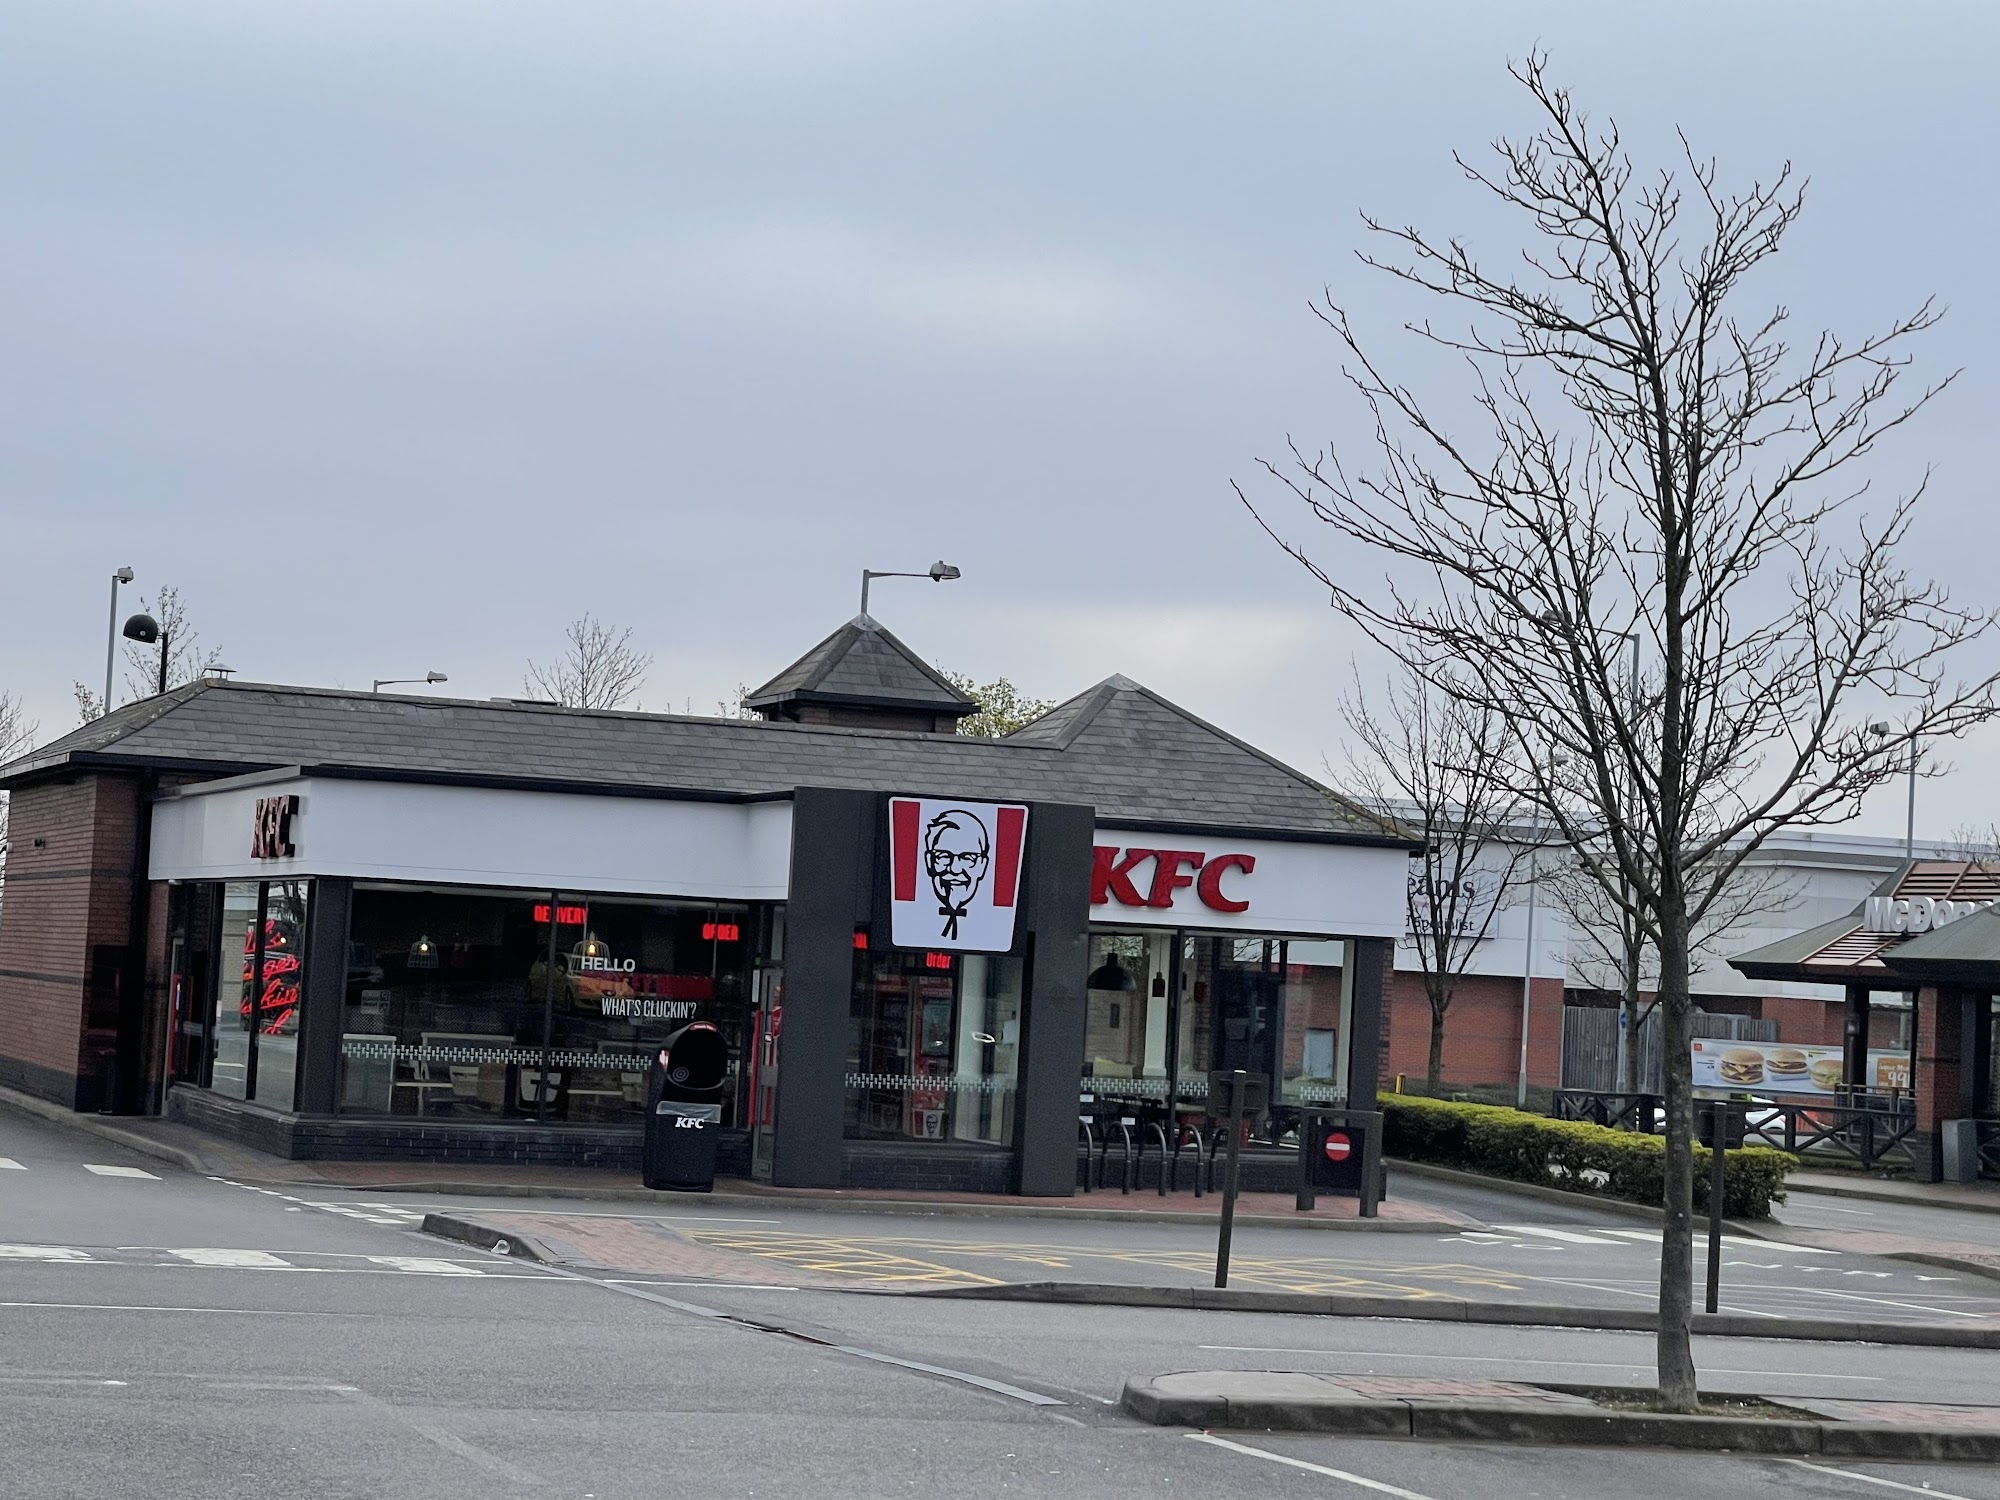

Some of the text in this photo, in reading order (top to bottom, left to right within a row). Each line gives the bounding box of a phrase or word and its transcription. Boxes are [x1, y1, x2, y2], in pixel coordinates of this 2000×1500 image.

[251, 795, 300, 858] KFC
[1090, 845, 1256, 913] KFC
[581, 956, 636, 972] HELLO
[601, 998, 697, 1019] WHAT'S CLUCKIN'?
[675, 1117, 704, 1129] KFC
